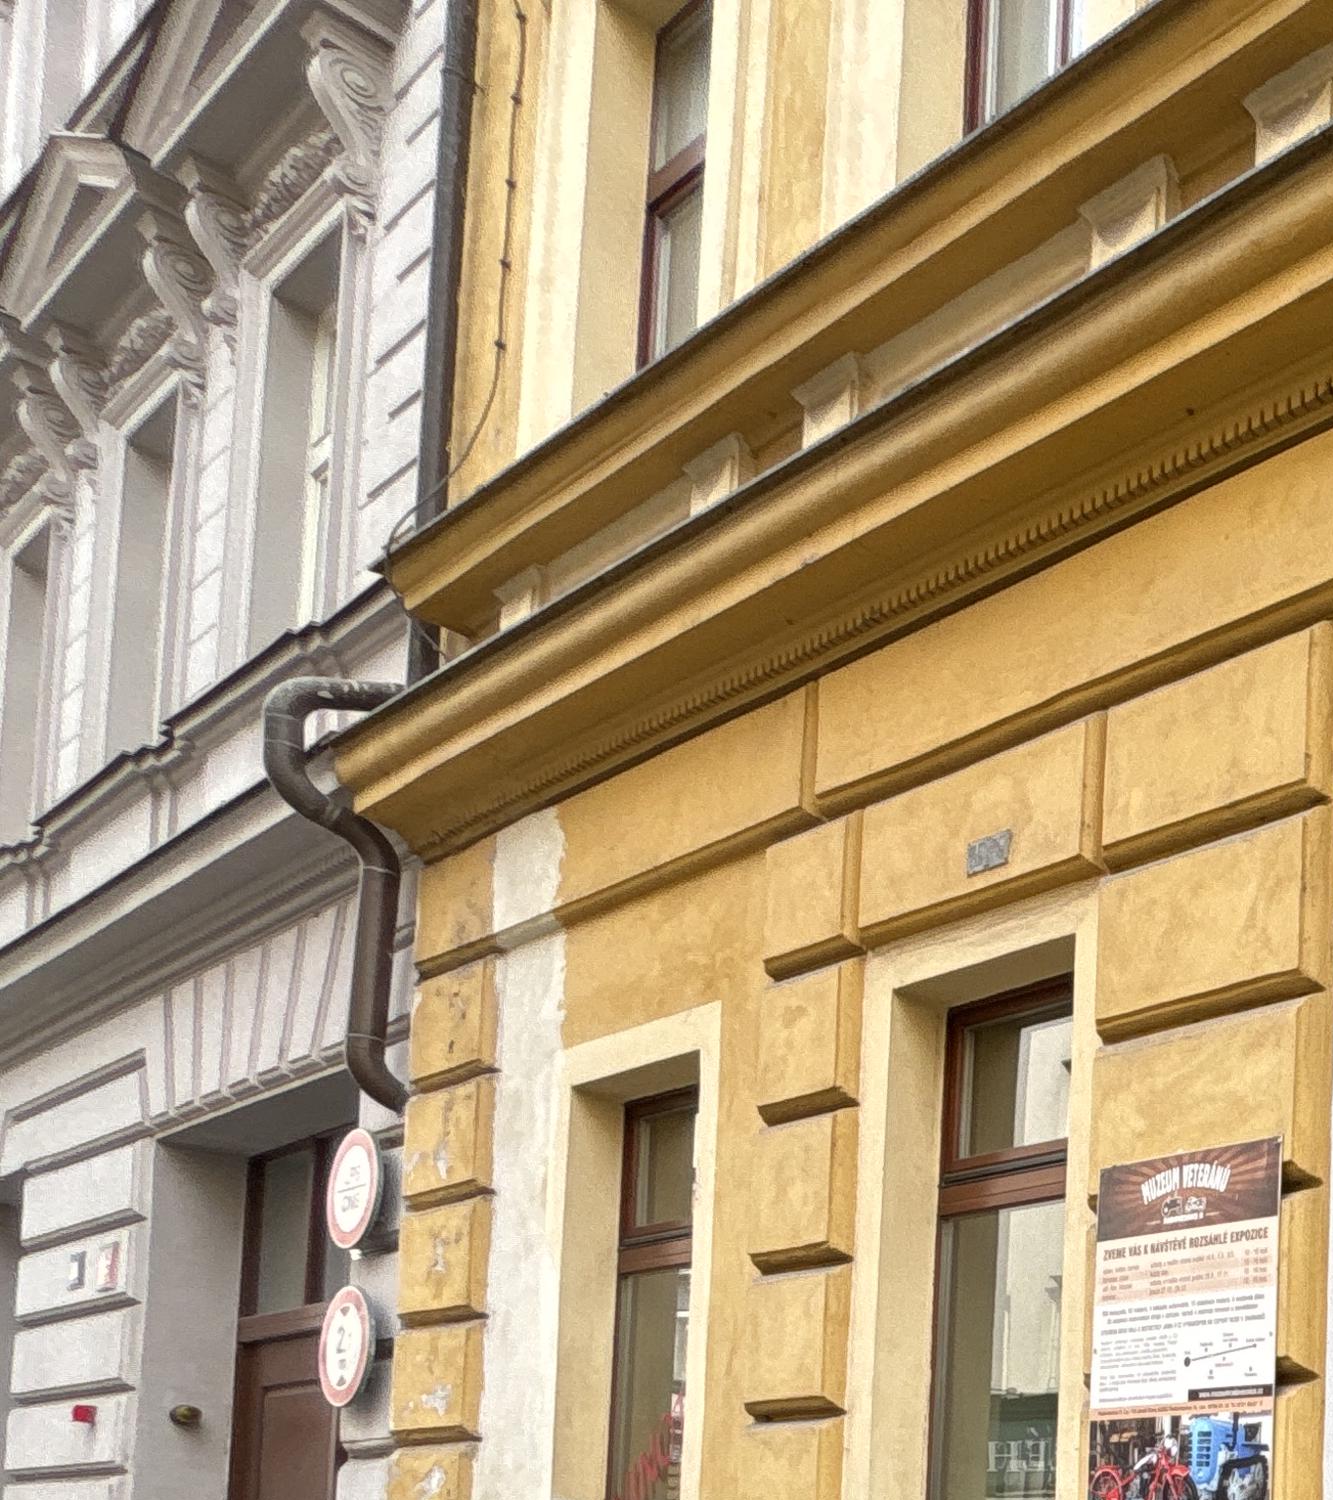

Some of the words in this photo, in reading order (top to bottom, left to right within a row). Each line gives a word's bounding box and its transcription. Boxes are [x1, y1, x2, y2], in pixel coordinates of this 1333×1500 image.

[1141, 1167, 1180, 1205] MUZEUM
[1103, 1246, 1127, 1262] ZVEME
[1230, 1226, 1269, 1243] EXPOZICE
